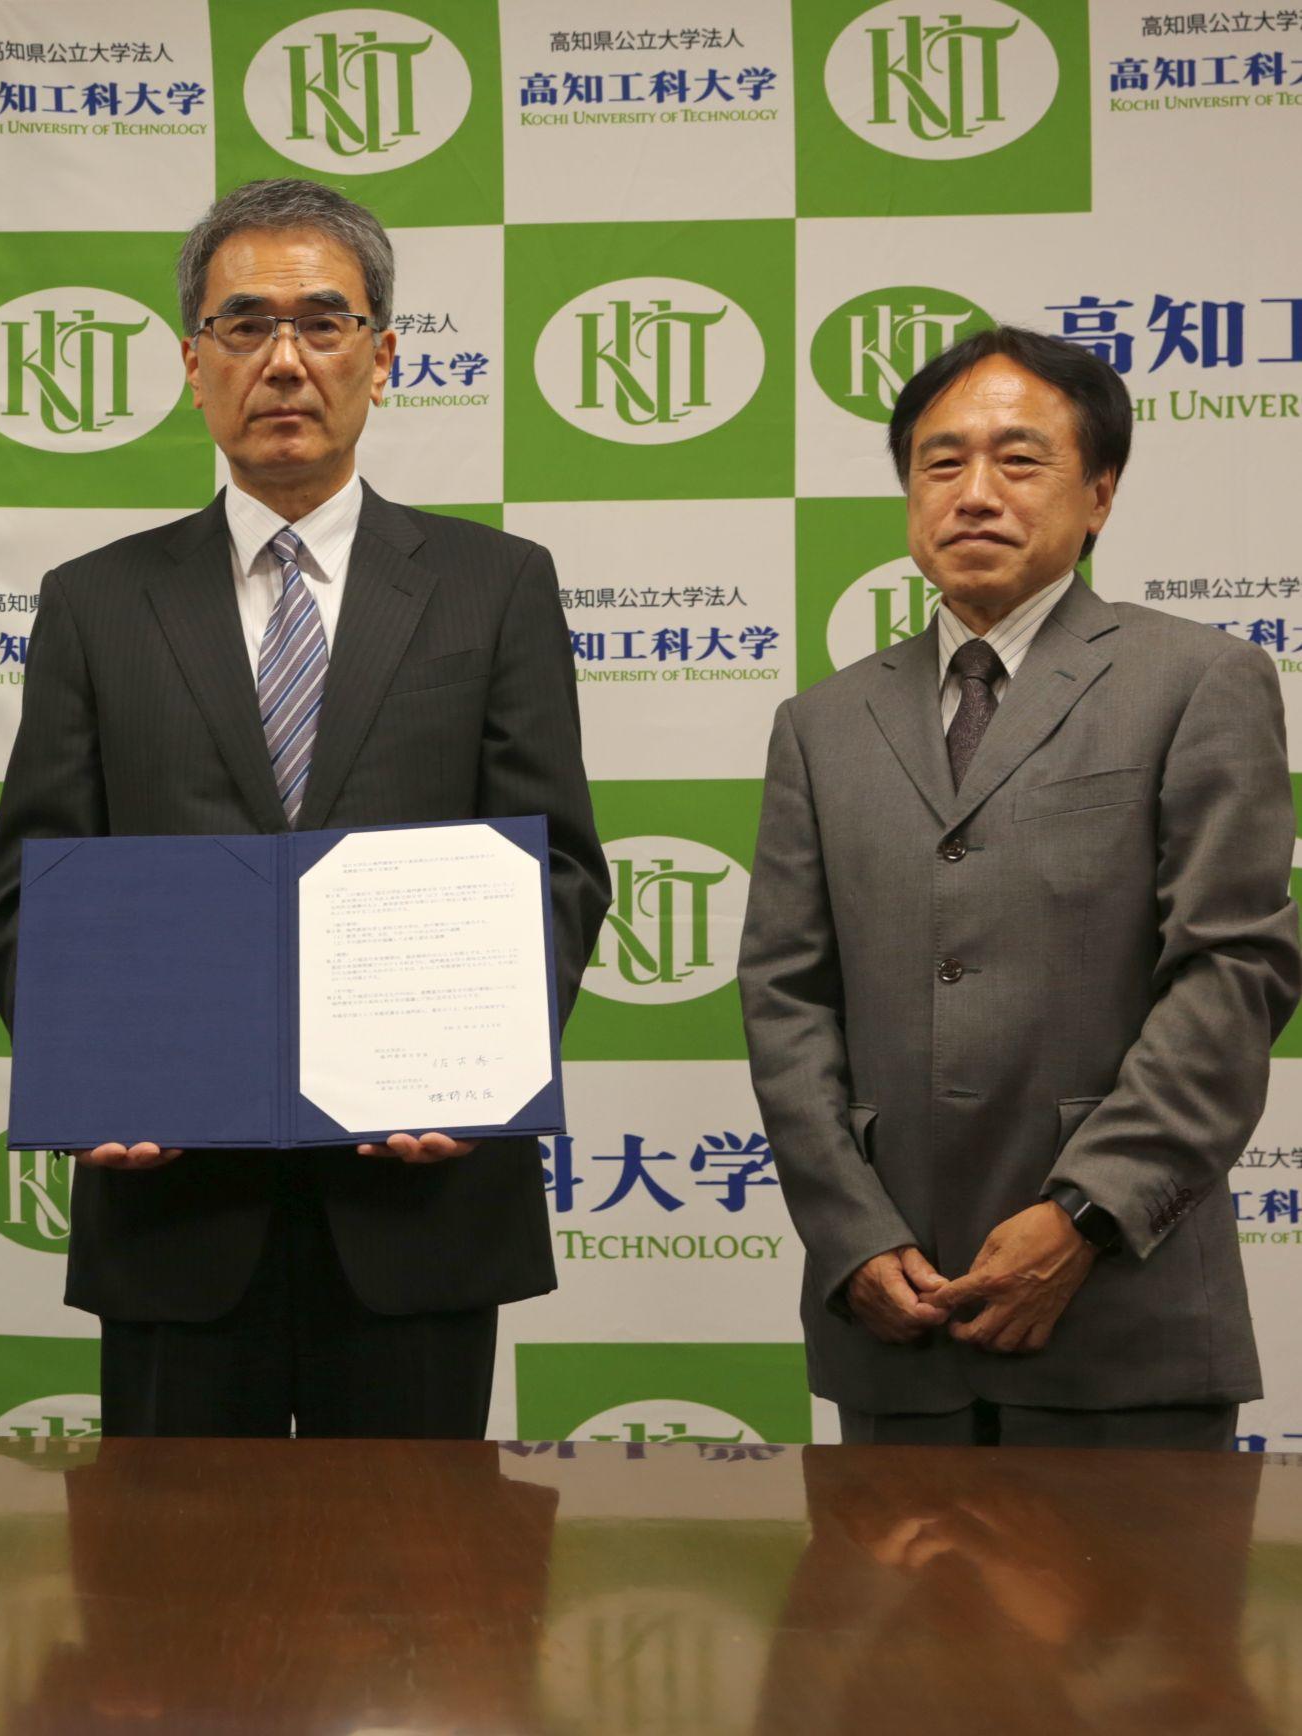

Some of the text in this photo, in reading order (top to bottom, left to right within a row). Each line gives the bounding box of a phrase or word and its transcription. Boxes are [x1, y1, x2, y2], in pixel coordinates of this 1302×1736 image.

[1141, 9, 1302, 37] 高知県公立大学
[550, 28, 745, 52] 高知県公立大学法人
[519, 67, 777, 106] 高知工科大学
[390, 313, 458, 335] 学法人
[559, 586, 747, 609] 高知県公立大学法人
[556, 1231, 783, 1259] TECHNOLOGY
